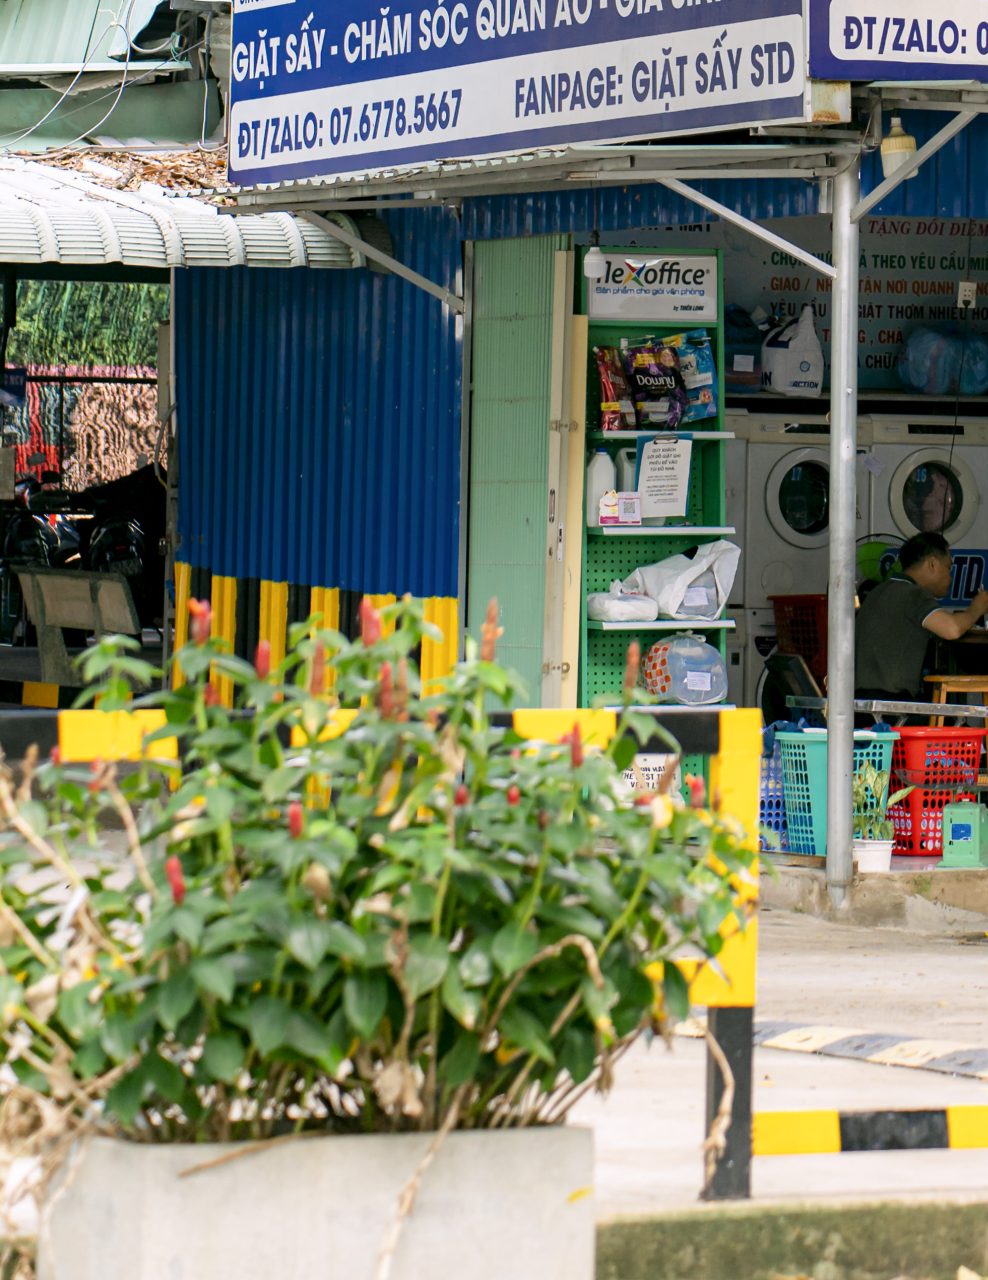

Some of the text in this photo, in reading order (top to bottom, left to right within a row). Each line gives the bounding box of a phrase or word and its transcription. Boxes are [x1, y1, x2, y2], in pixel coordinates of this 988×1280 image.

[233, 37, 280, 89] GIẶT
[286, 12, 325, 73] SẤY
[344, 7, 411, 63] CHĂM
[844, 16, 966, 54] ĐT/ZALO:
[238, 30, 794, 159] ĐT/ZALO: 07.6778.5667 FANPAGE: GIẶT SẤY STD
[872, 255, 906, 269] THEO
[911, 252, 936, 270] YÊU
[770, 276, 800, 292] GIAO
[912, 280, 954, 297] QUANH
[636, 375, 676, 389] Downy
